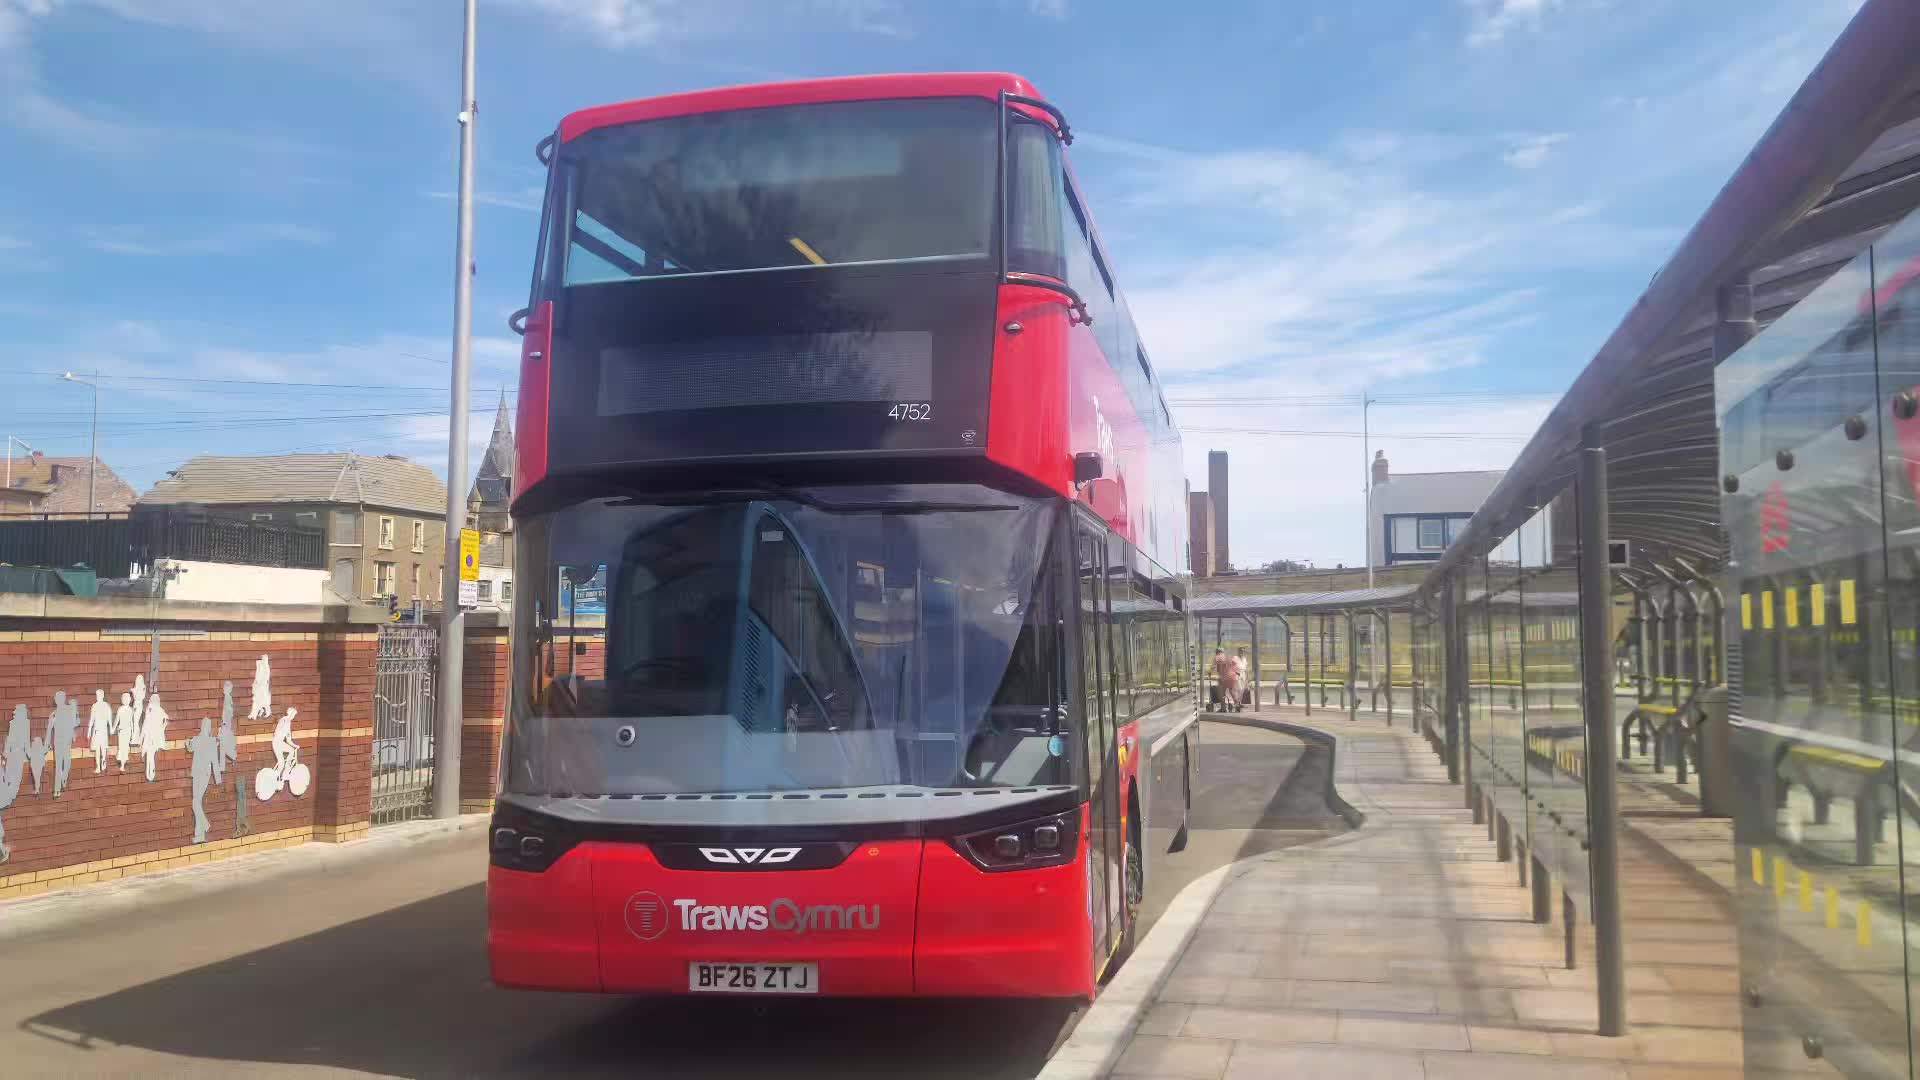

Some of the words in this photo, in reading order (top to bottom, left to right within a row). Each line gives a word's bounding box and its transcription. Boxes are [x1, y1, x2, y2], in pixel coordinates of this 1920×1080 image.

[888, 403, 931, 420] 4752
[673, 897, 880, 934] TrawsCymru
[698, 965, 756, 987] BF26
[763, 966, 808, 989] ZTJ
